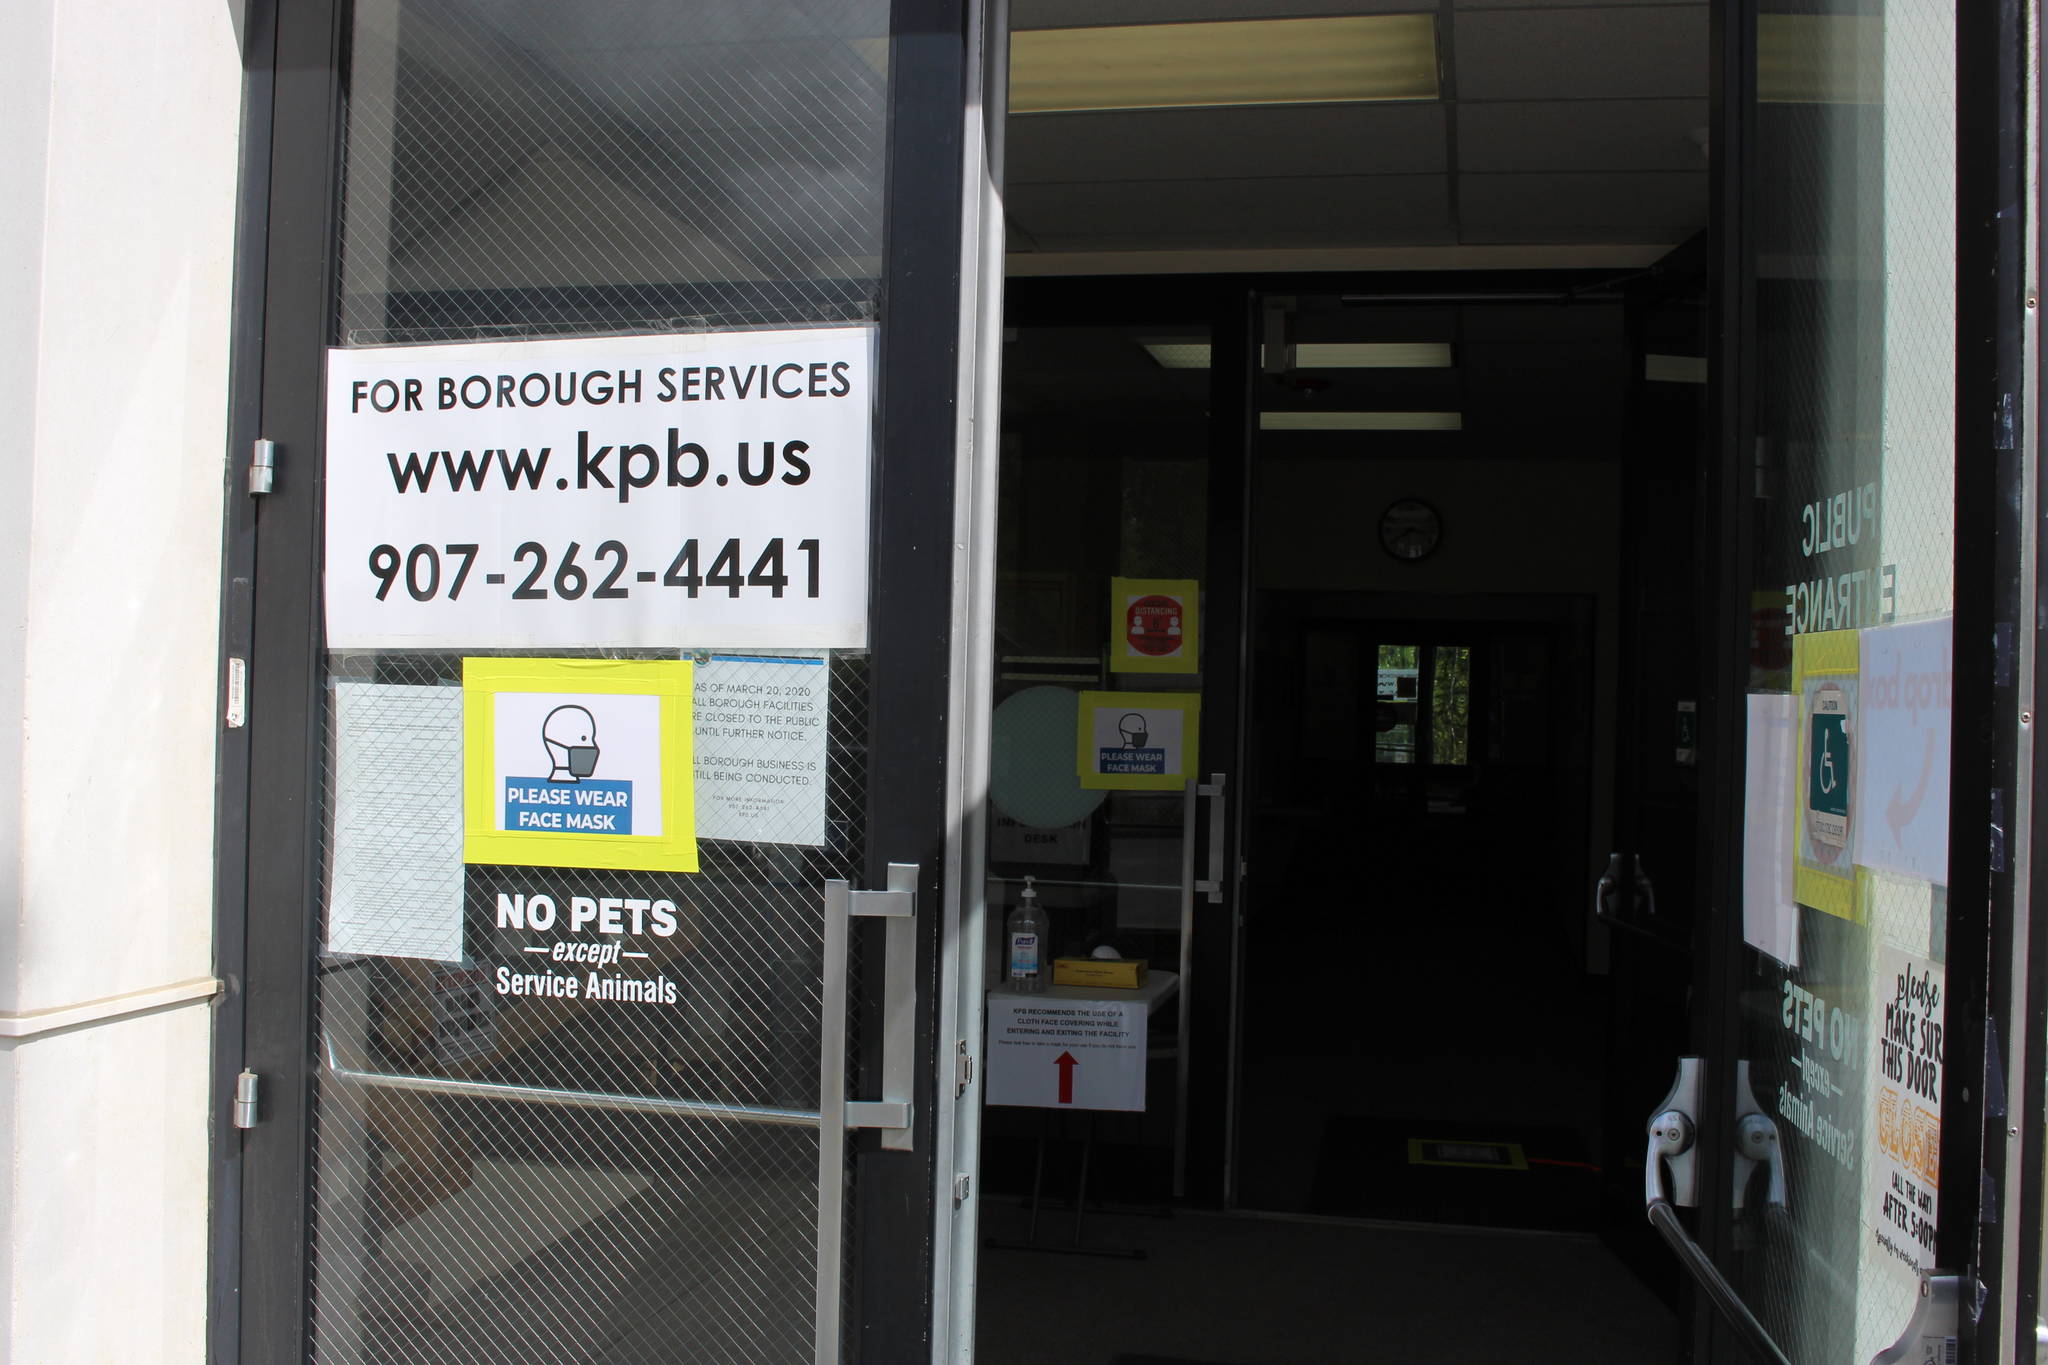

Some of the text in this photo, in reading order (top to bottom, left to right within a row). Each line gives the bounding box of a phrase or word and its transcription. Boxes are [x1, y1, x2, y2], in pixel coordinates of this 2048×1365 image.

[351, 361, 851, 413] FOR BOROUGH SERVICES
[387, 428, 811, 503] www.kpb.us
[369, 538, 820, 601] 907-262-4441
[695, 683, 811, 698] AS OF MARCH 20, 2020
[710, 699, 760, 710] BOROUGH
[764, 701, 814, 712] FACILITIES
[705, 713, 746, 723] CLOSED
[749, 715, 762, 724] TO
[765, 715, 782, 725] THE
[785, 716, 820, 727] PUBLIC
[695, 727, 807, 742] UNTIL FURTHER NOTICE.
[703, 757, 753, 767] BOROUGH
[757, 758, 805, 771] BUSINESS
[807, 762, 817, 772] IS
[1101, 752, 1163, 762] PLEASE WEAR
[714, 772, 742, 781] BEING
[1107, 764, 1156, 773] FACE MASK
[508, 787, 628, 808] PLEASE WEAR
[519, 811, 615, 830] FACE MASK
[496, 893, 677, 938] NO PETS
[496, 967, 579, 999] Service
[585, 972, 677, 1004] Animals
[1895, 962, 1940, 1018] please
[1028, 1008, 1075, 1017] RECOMMENDS
[1007, 1027, 1040, 1035] ENTERING
[1056, 1029, 1082, 1037] EXITING
[1099, 1030, 1130, 1038] FACILITY
[1041, 1018, 1058, 1026] FACE
[1060, 1019, 1095, 1028] COVERING
[1886, 1002, 1915, 1051] MAKE
[1881, 1038, 1937, 1104] THIS DOOR
[1905, 1180, 1916, 1206] THE
[1883, 1191, 1908, 1233] AFTER
